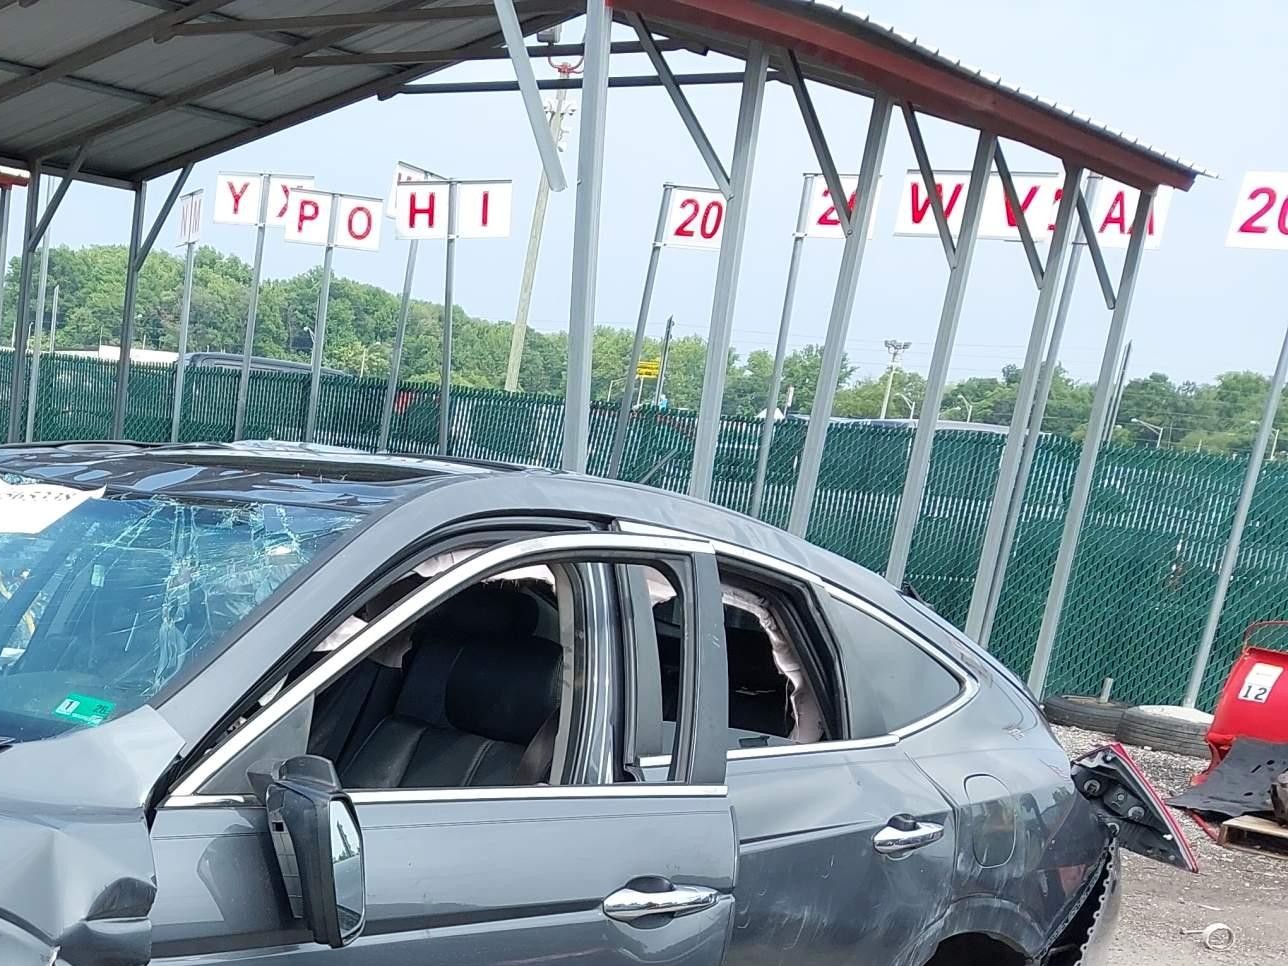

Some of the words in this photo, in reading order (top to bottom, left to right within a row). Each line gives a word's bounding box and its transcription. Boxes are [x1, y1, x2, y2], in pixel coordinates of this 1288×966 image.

[227, 182, 251, 215] Y
[409, 192, 435, 229] H
[482, 191, 490, 226] I
[816, 188, 857, 226] 2
[910, 182, 964, 225] W
[297, 199, 320, 233] P
[347, 206, 373, 241] O
[674, 198, 723, 239] 20
[1243, 685, 1268, 701] 12
